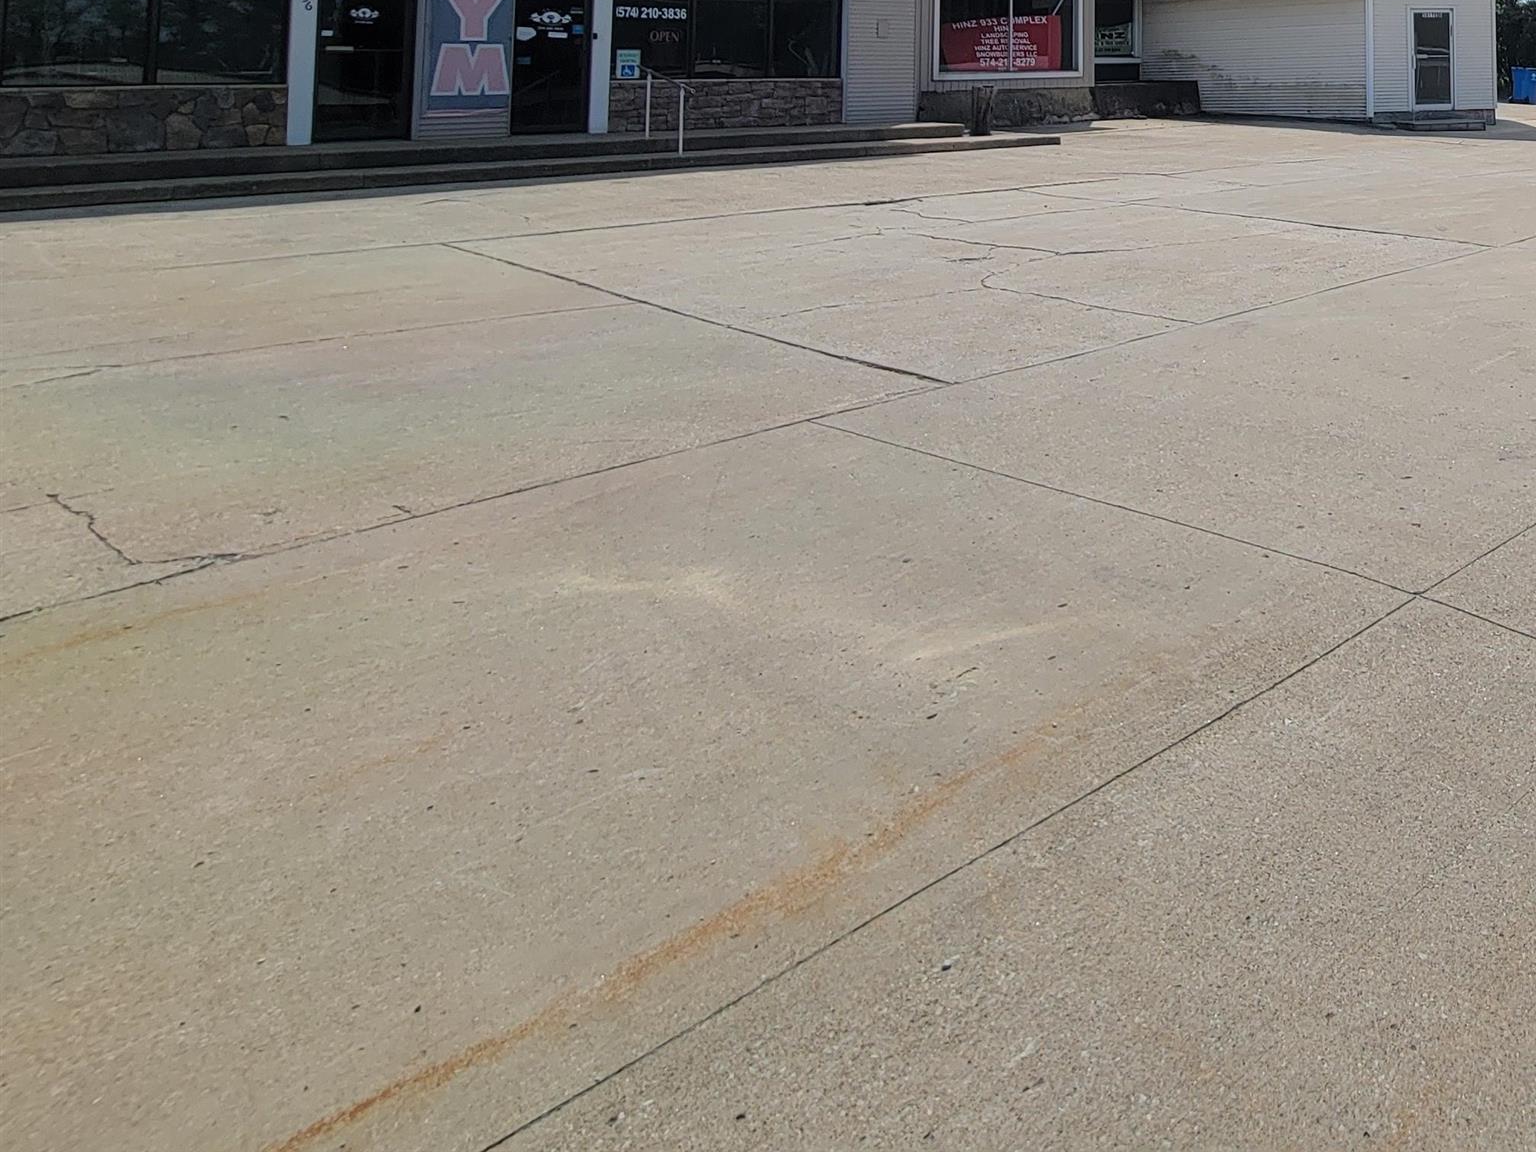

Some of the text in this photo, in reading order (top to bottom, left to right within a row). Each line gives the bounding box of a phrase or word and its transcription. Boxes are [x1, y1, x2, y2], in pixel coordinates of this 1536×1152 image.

[615, 6, 687, 20] (574) 210-3836
[952, 19, 978, 30] HINZ
[980, 17, 998, 27] 933
[649, 30, 680, 42] OPEN
[980, 57, 1036, 67] 574-21-8279
